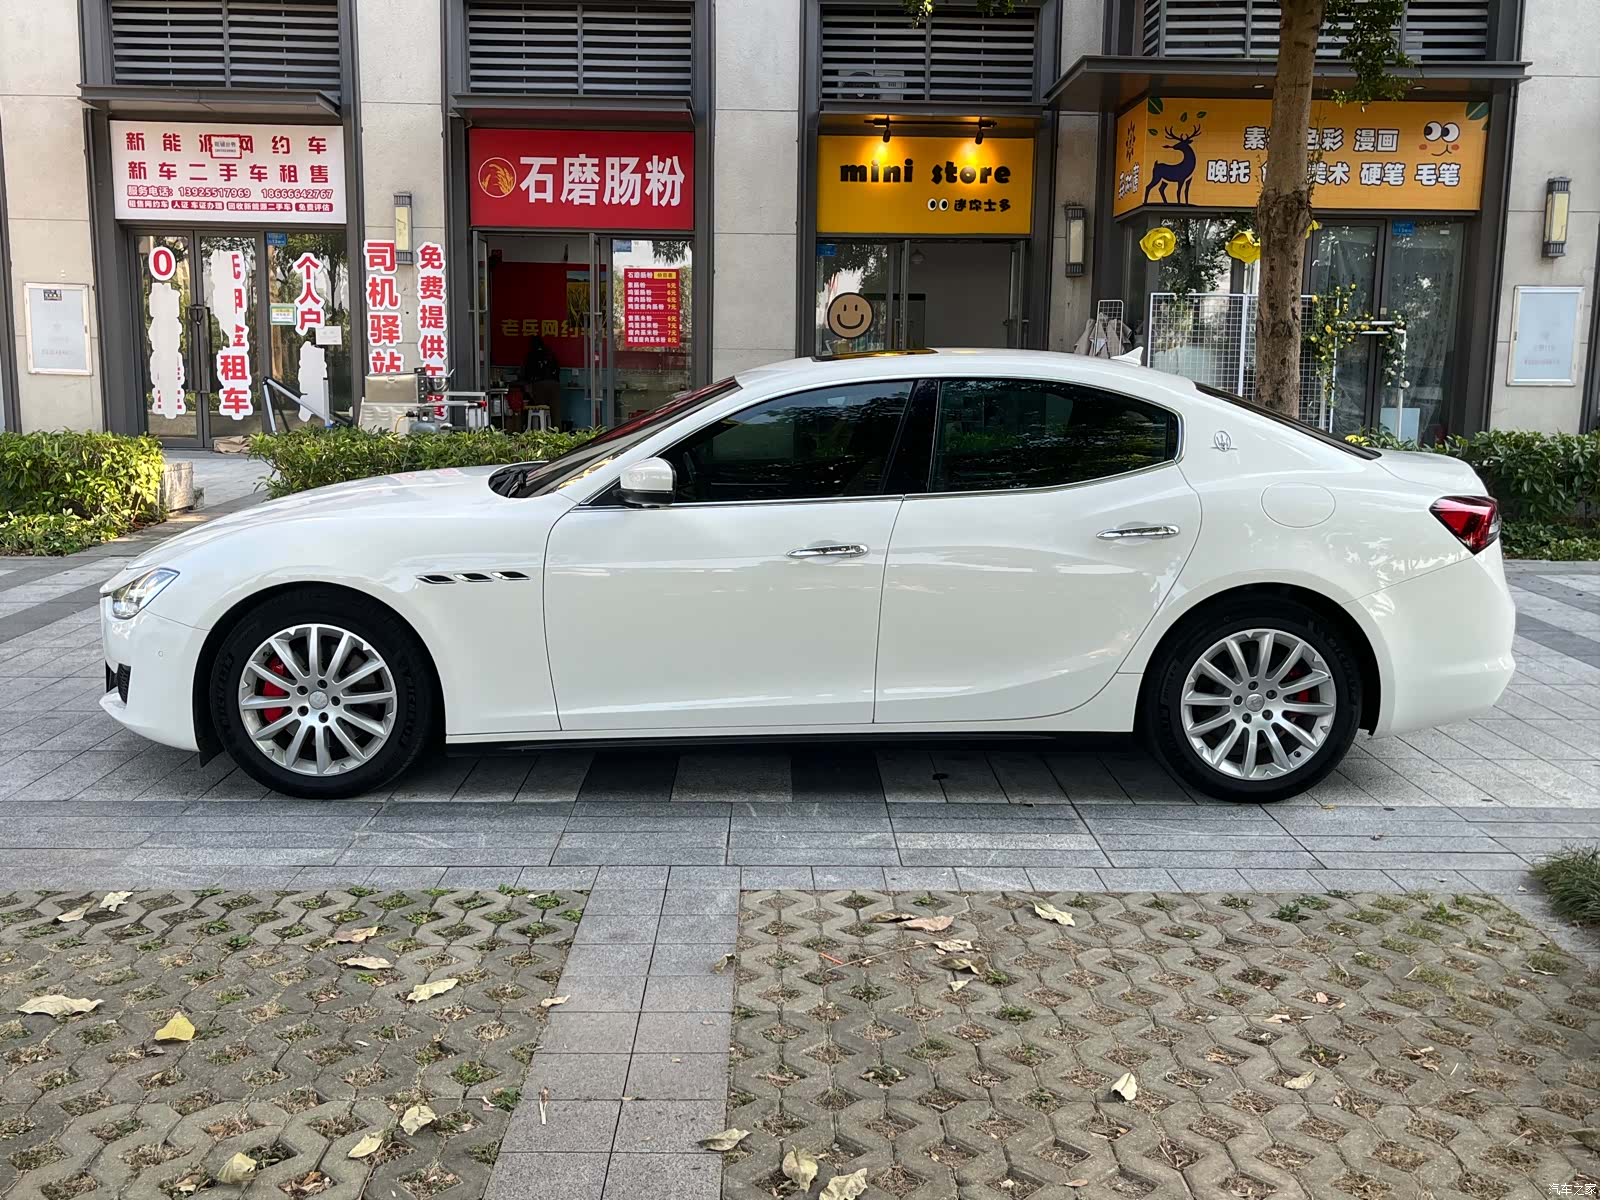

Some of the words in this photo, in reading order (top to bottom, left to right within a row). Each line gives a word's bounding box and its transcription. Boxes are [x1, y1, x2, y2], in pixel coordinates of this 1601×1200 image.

[1243, 126, 1270, 150] 素
[1352, 127, 1400, 152] 漫画
[128, 161, 329, 184] 新车二手车租售
[519, 153, 686, 207] 石磨肠粉
[840, 158, 914, 183] mini
[931, 161, 1012, 185] store
[1206, 159, 1251, 184] 晚托
[1360, 162, 1405, 186] 硬笔
[1414, 163, 1460, 187] 毛笔
[178, 186, 251, 199] 13925517969
[261, 188, 333, 200] 18666642767
[954, 199, 1012, 212] 迷你士多
[298, 203, 331, 212] 免费评估
[366, 242, 402, 374] 司机驿站
